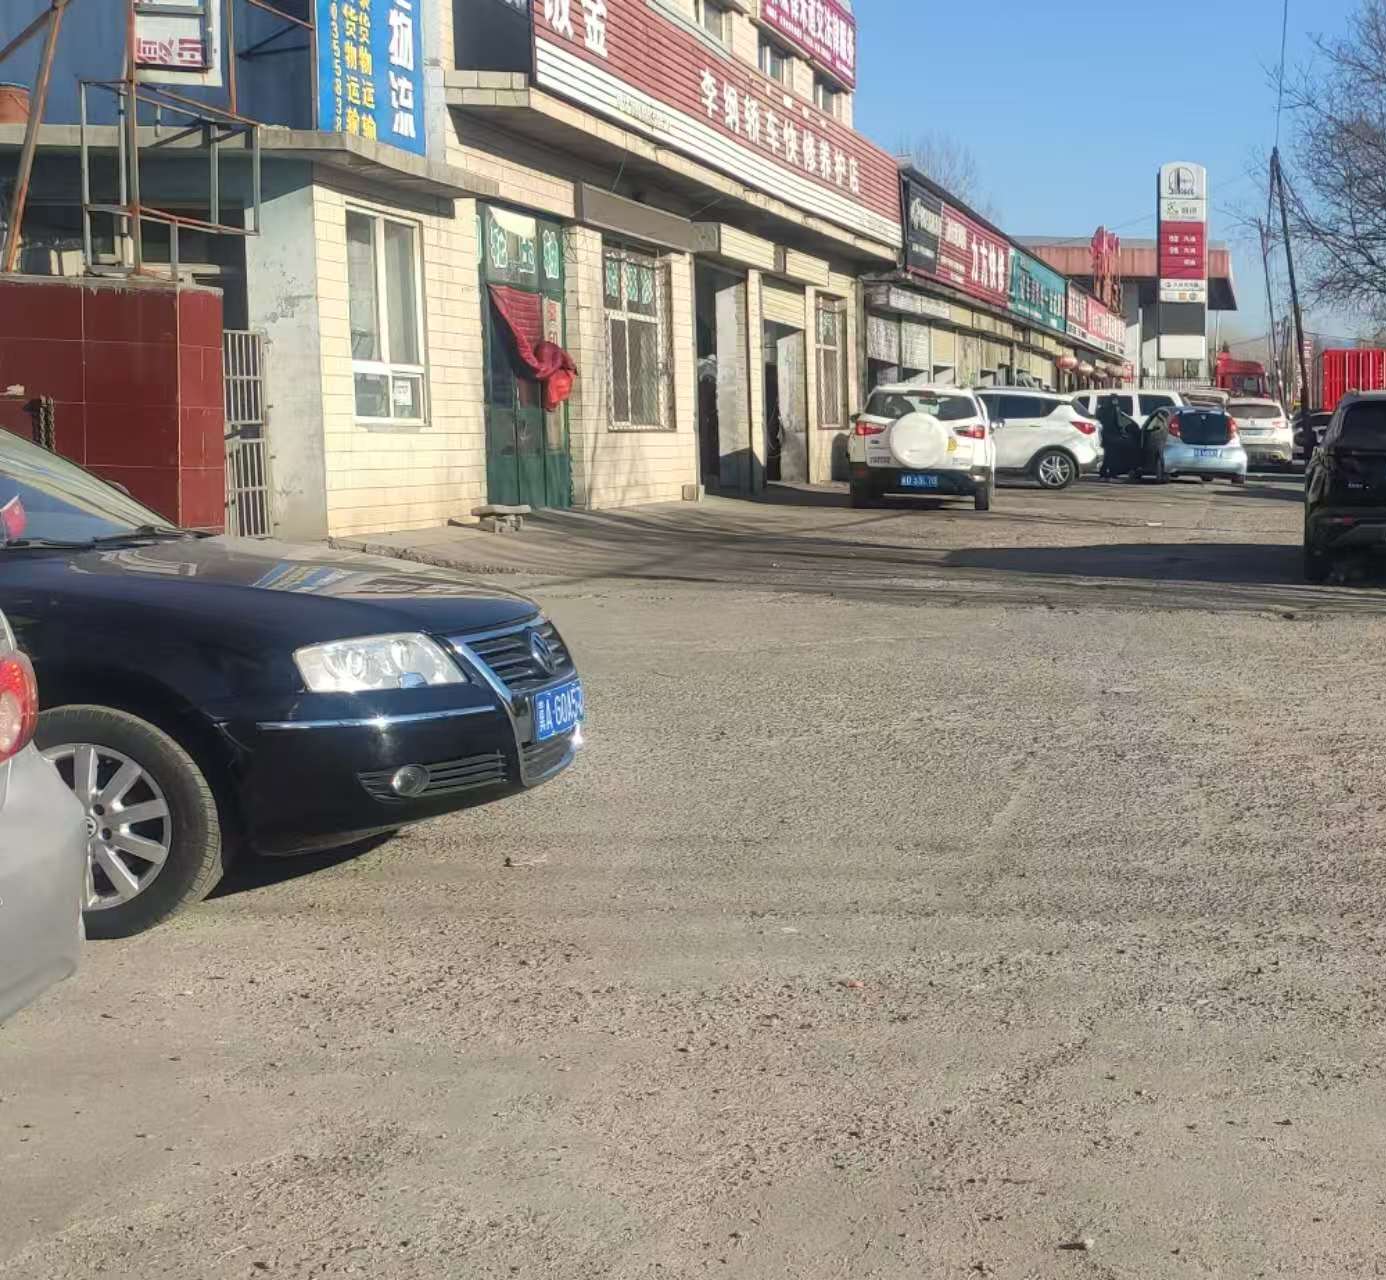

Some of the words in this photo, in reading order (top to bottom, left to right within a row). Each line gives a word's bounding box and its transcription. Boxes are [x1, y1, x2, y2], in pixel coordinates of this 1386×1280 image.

[359, 0, 376, 140] 货物运输
[388, 0, 415, 138] 物流
